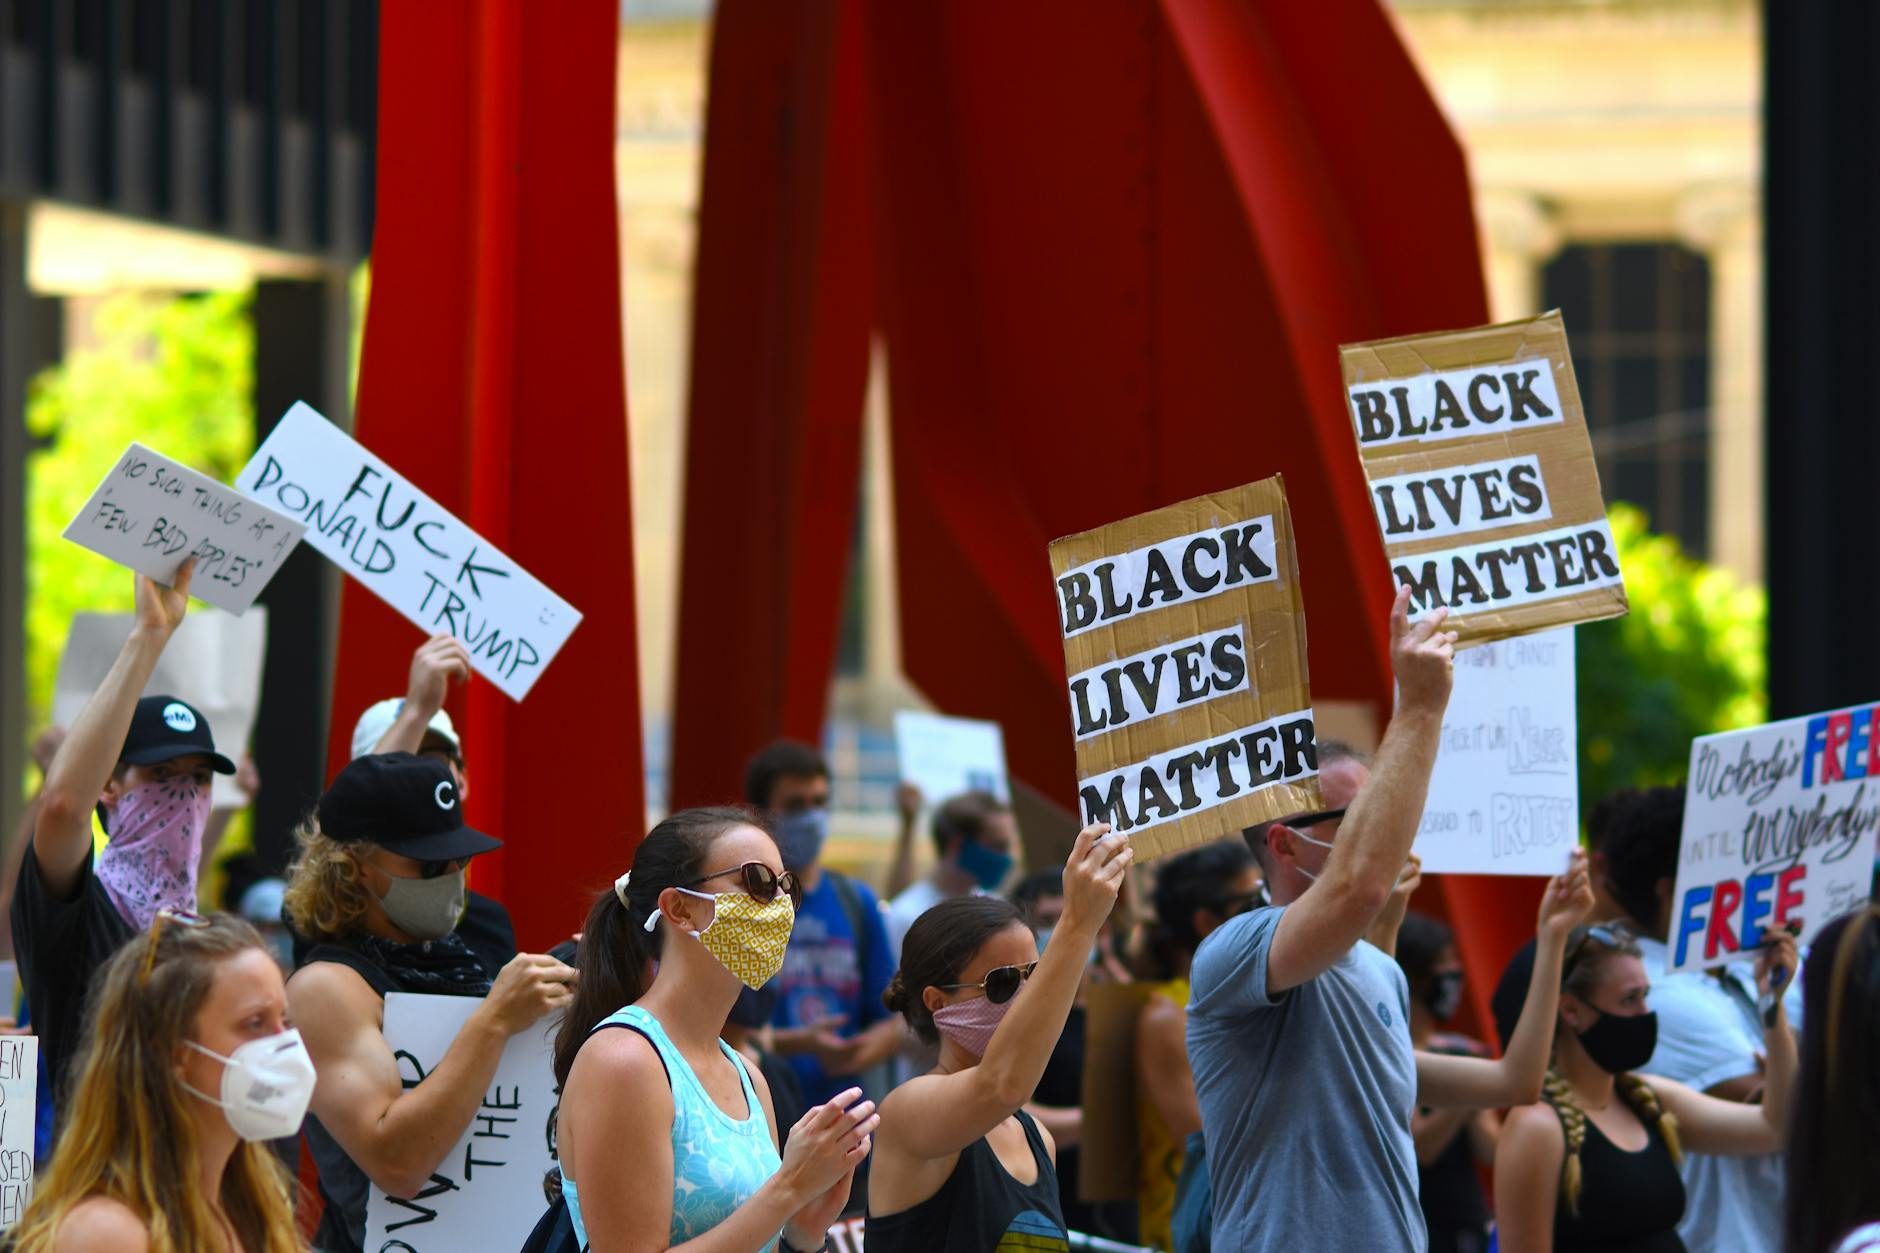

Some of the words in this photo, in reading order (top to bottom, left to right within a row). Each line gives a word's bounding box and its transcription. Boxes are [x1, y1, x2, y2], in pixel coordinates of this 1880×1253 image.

[1352, 369, 1553, 442] BLACK
[121, 457, 148, 479] NO
[149, 468, 185, 499] SUCH
[192, 488, 242, 524] THING
[142, 516, 188, 555] BAD
[343, 464, 511, 600] FUCK
[1375, 464, 1544, 535] LIVES
[253, 455, 396, 575] DONALD
[419, 570, 540, 681] TRUMP
[1058, 524, 1272, 633] BLACK
[1393, 530, 1620, 617] MATTER
[1071, 633, 1245, 736] LIVES
[434, 780, 456, 811] C
[1080, 718, 1319, 832] MATTER
[1673, 862, 1807, 968] FREE
[464, 1085, 522, 1182] THE
